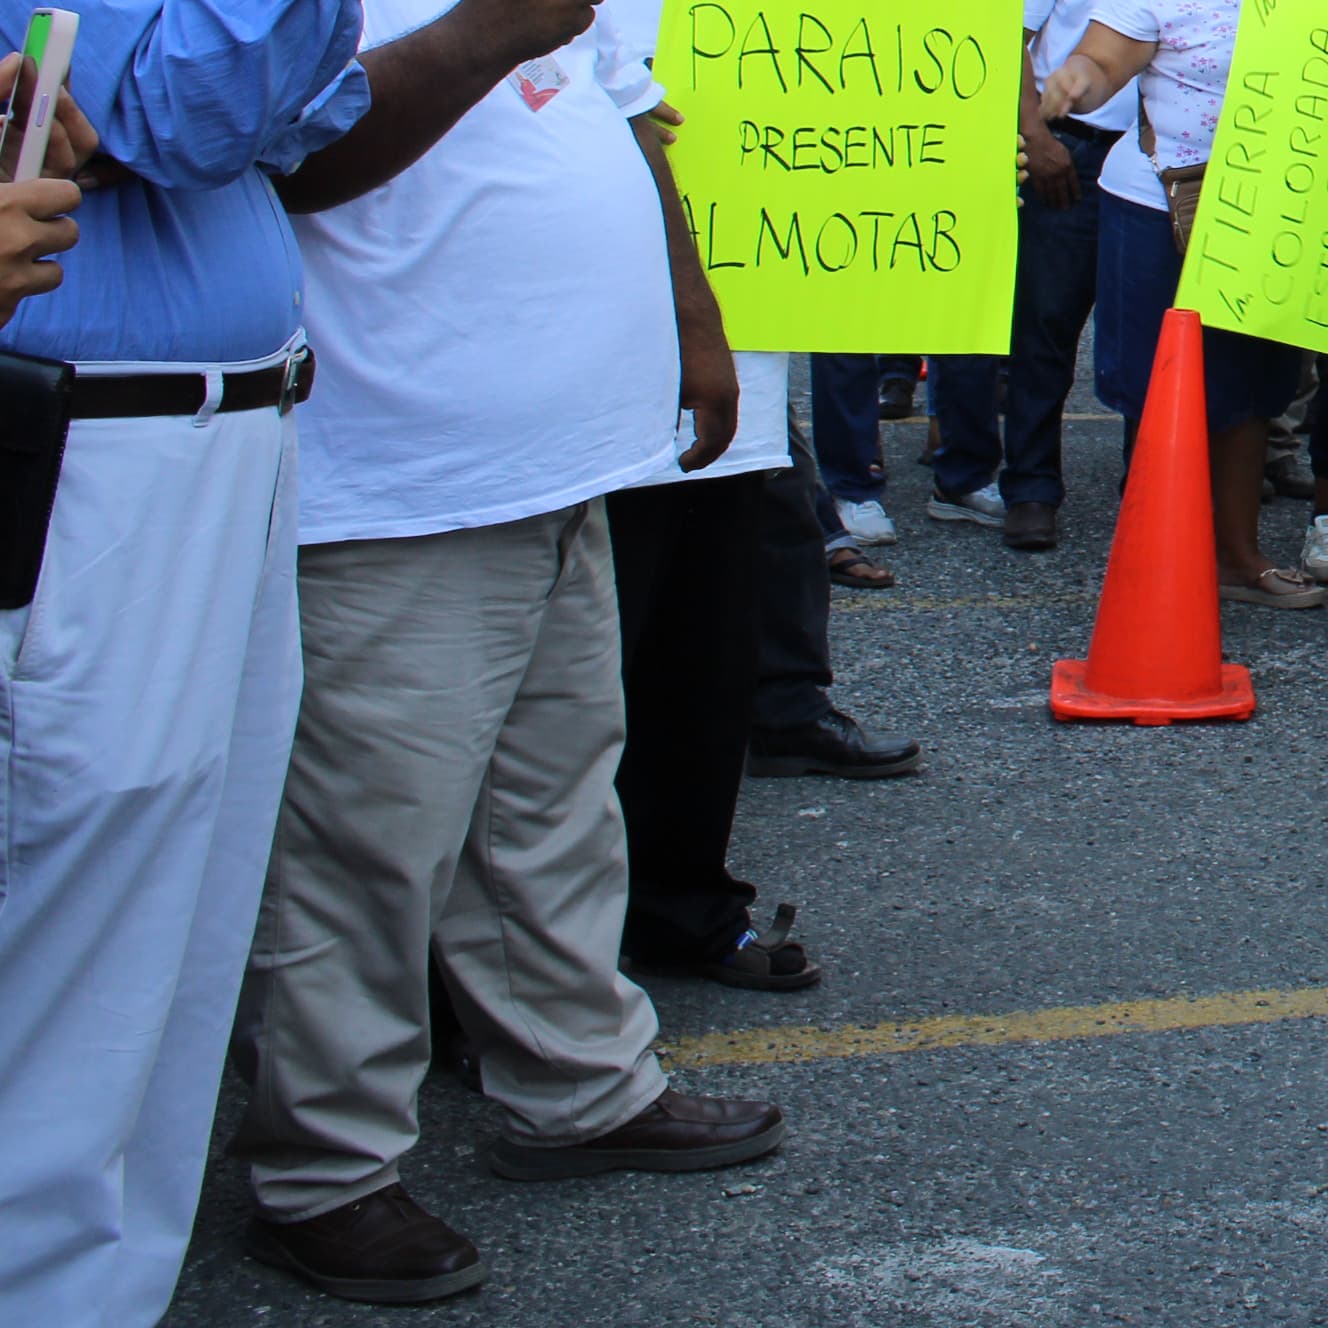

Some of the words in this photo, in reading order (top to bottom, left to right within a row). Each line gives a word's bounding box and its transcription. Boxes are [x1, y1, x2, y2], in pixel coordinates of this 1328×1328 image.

[689, 2, 987, 100] PARAISO
[740, 119, 946, 174] PRESENTE
[1197, 70, 1280, 286] TIERRA
